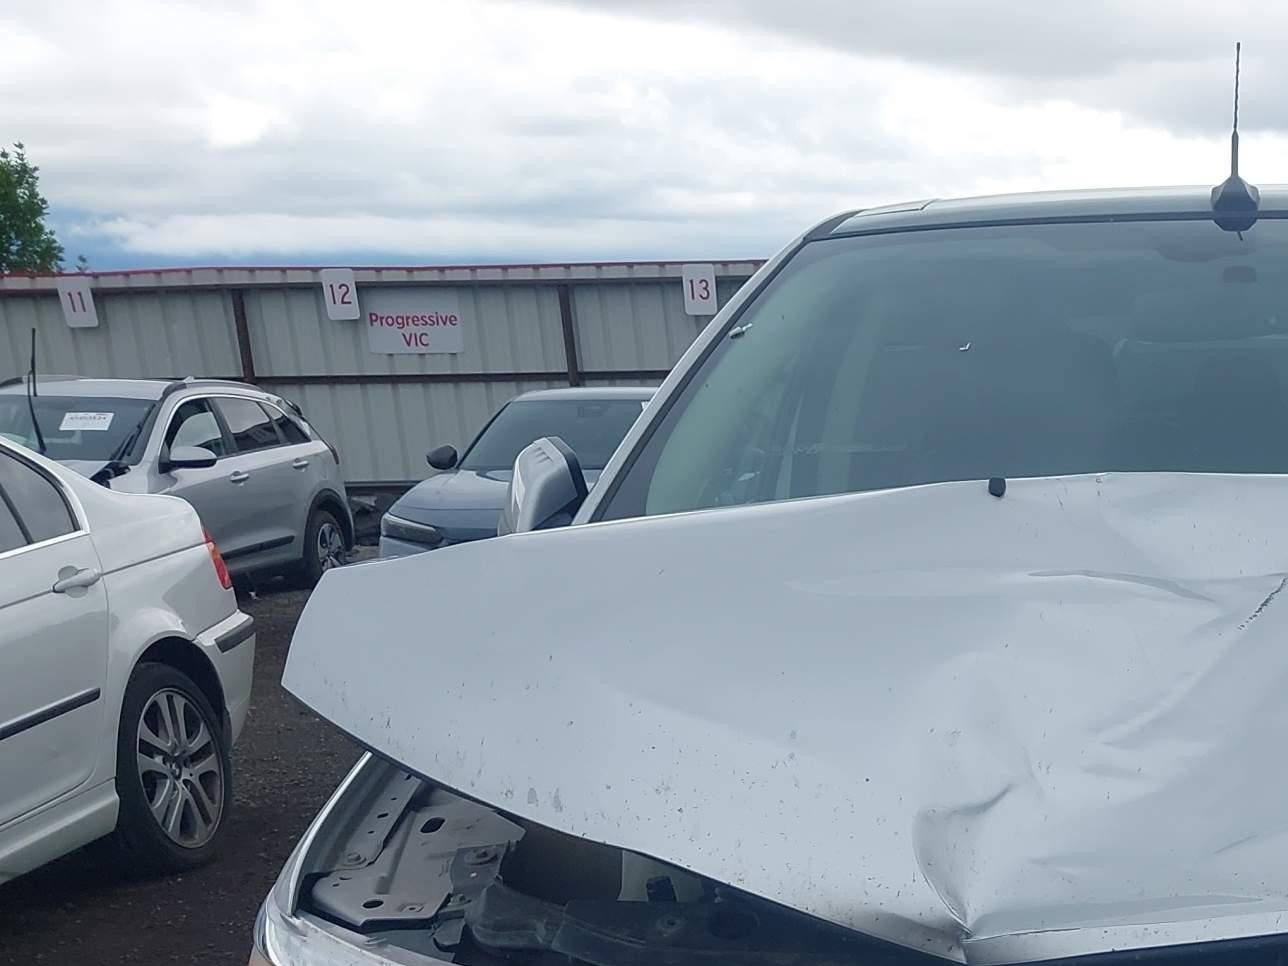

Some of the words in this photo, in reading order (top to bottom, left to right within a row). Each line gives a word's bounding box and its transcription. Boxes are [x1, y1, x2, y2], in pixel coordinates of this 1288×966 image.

[329, 283, 352, 305] 12
[689, 279, 710, 300] 13
[67, 291, 87, 313] 11
[368, 311, 459, 330] Progressive
[401, 332, 430, 347] VIC
